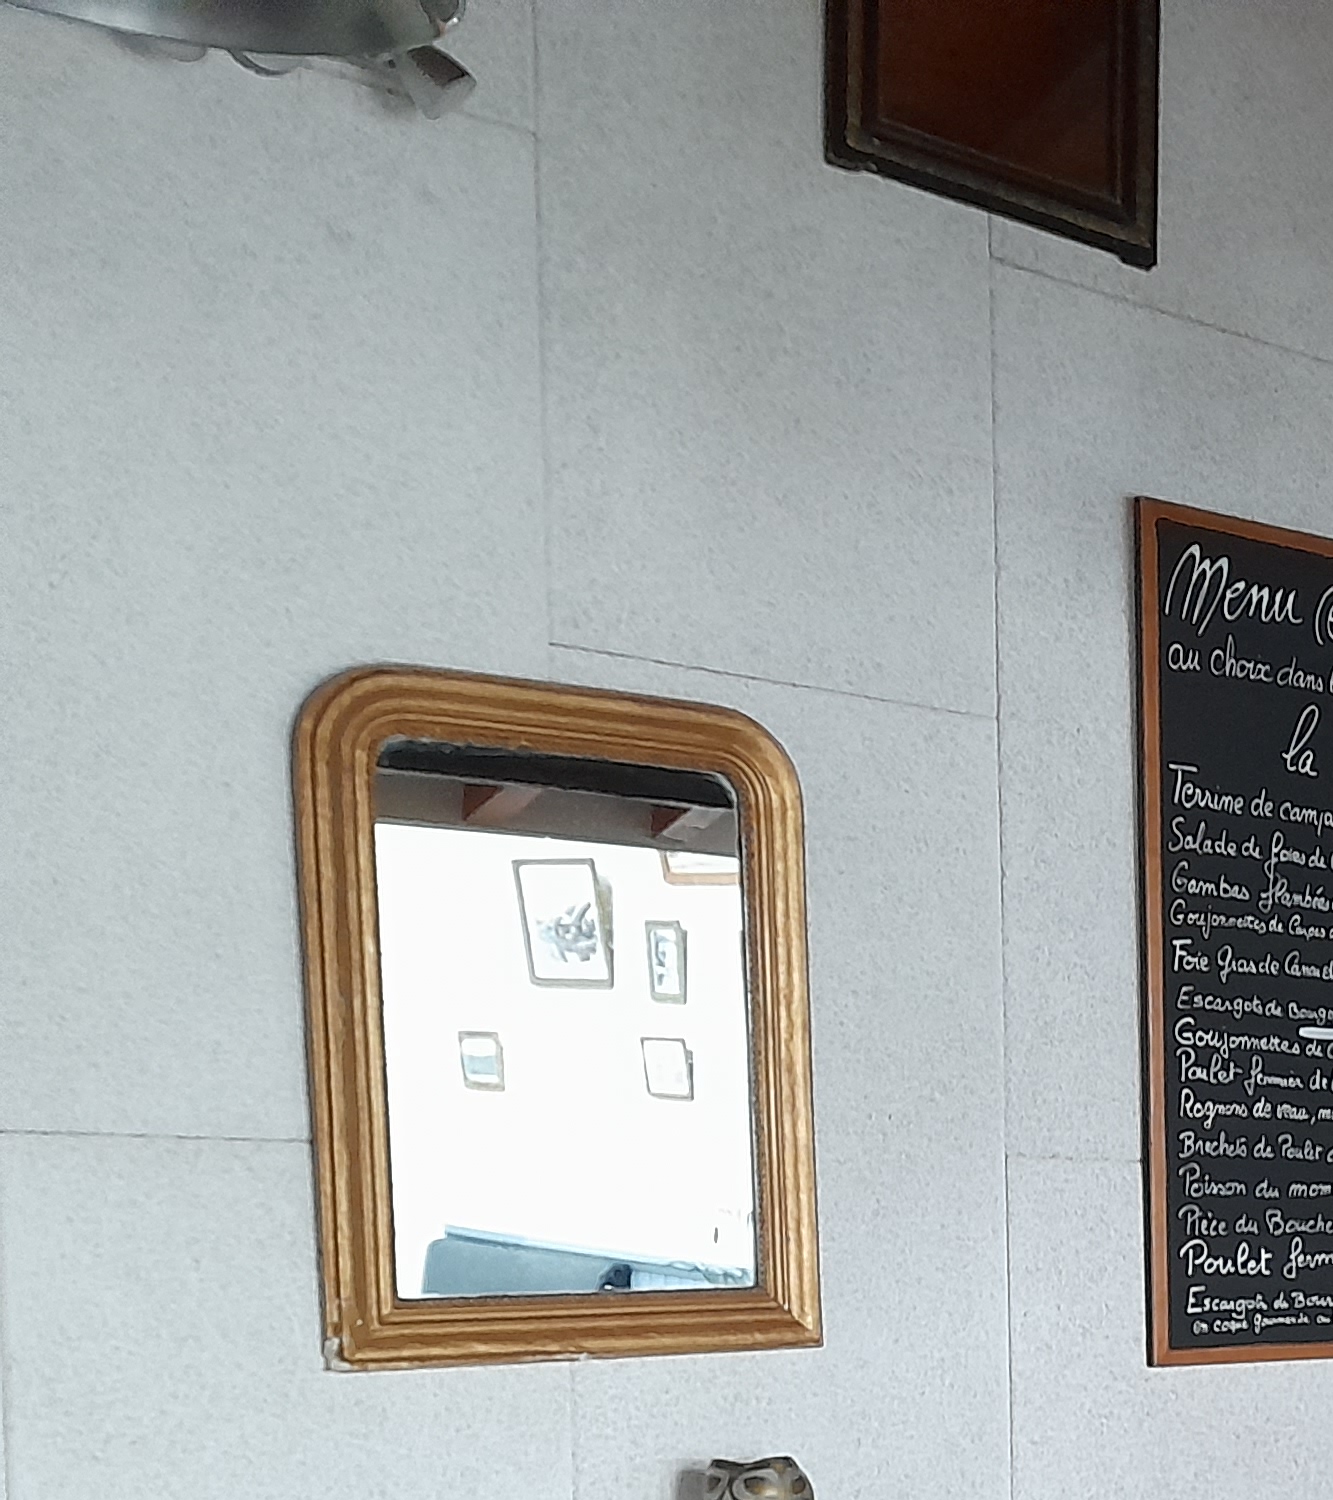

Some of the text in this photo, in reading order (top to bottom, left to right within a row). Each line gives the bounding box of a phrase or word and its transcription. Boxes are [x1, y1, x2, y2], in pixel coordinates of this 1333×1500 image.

[1164, 543, 1303, 636] Menu
[1168, 642, 1201, 672] au
[1210, 634, 1275, 684] choix
[1276, 657, 1324, 693] dans
[1281, 704, 1318, 777] la
[1168, 763, 1244, 815] Terrine
[1250, 788, 1273, 817] de
[1168, 816, 1237, 856] Salade
[1241, 836, 1264, 859] de
[1308, 846, 1327, 869] de
[1171, 860, 1250, 900] Gambas
[1269, 914, 1284, 933] de
[1172, 938, 1210, 972] Foie
[1259, 953, 1280, 976] de
[1177, 985, 1264, 1020] Escargots
[1265, 1000, 1283, 1018] de
[1174, 1016, 1300, 1059] Goujonnettes
[1305, 1040, 1324, 1058] de
[1175, 1047, 1244, 1084] Poulet
[1309, 1068, 1327, 1091] de
[1179, 1087, 1248, 1129] Rognons
[1252, 1096, 1272, 1119] de
[1253, 1134, 1275, 1158] de
[1278, 1133, 1323, 1160] Poulet
[1178, 1162, 1247, 1198] Poisson
[1255, 1178, 1280, 1199] du
[1235, 1214, 1260, 1235] du
[1179, 1238, 1273, 1277] Poulet
[1273, 1291, 1289, 1310] de
